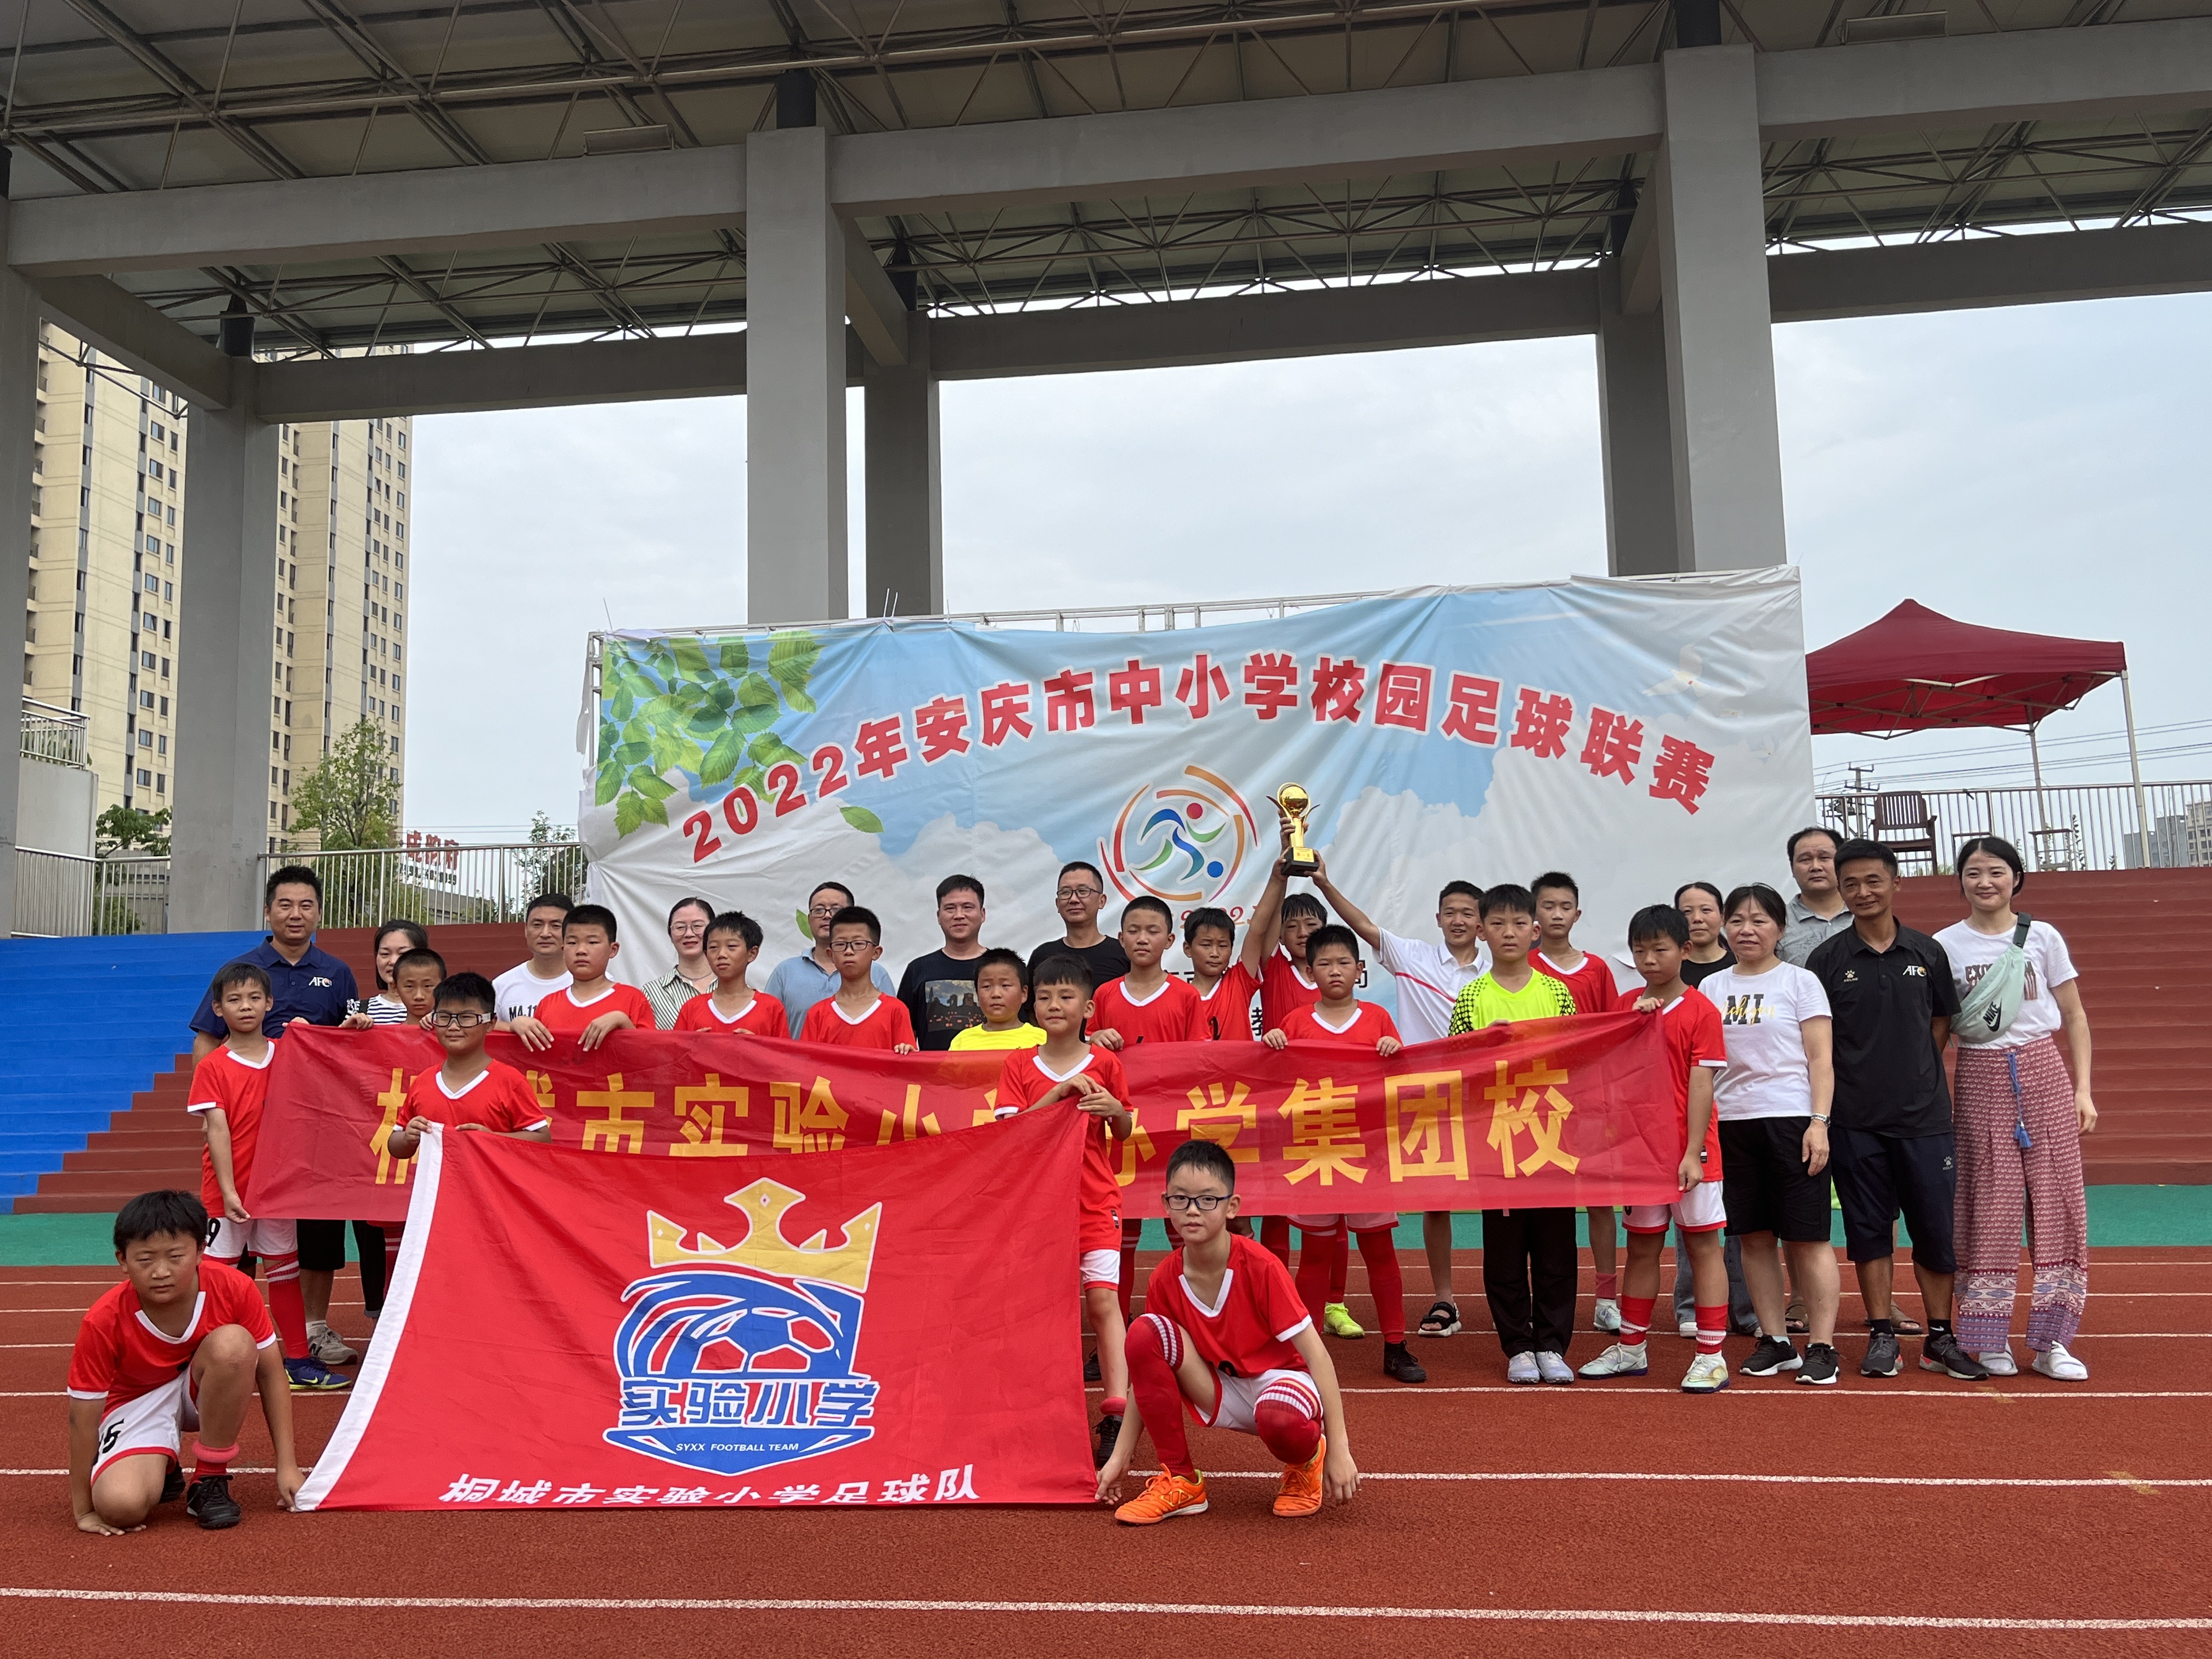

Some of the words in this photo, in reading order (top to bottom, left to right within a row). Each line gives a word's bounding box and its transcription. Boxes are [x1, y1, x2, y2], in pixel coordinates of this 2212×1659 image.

[682, 649, 1716, 865] 2022年安庆市中小学校园足球联赛
[308, 977, 332, 988] AFC
[1903, 965, 1927, 977] AFC
[1983, 1001, 2000, 1025] NIKE
[369, 1059, 1581, 1187] 市实验小学集团校
[620, 1379, 879, 1427] 实验小学
[675, 1443, 706, 1452] SYXX
[710, 1443, 766, 1452] FOOTBALL
[769, 1443, 799, 1452] TEAM
[438, 1463, 981, 1505] 桐城市实验小学足球队
